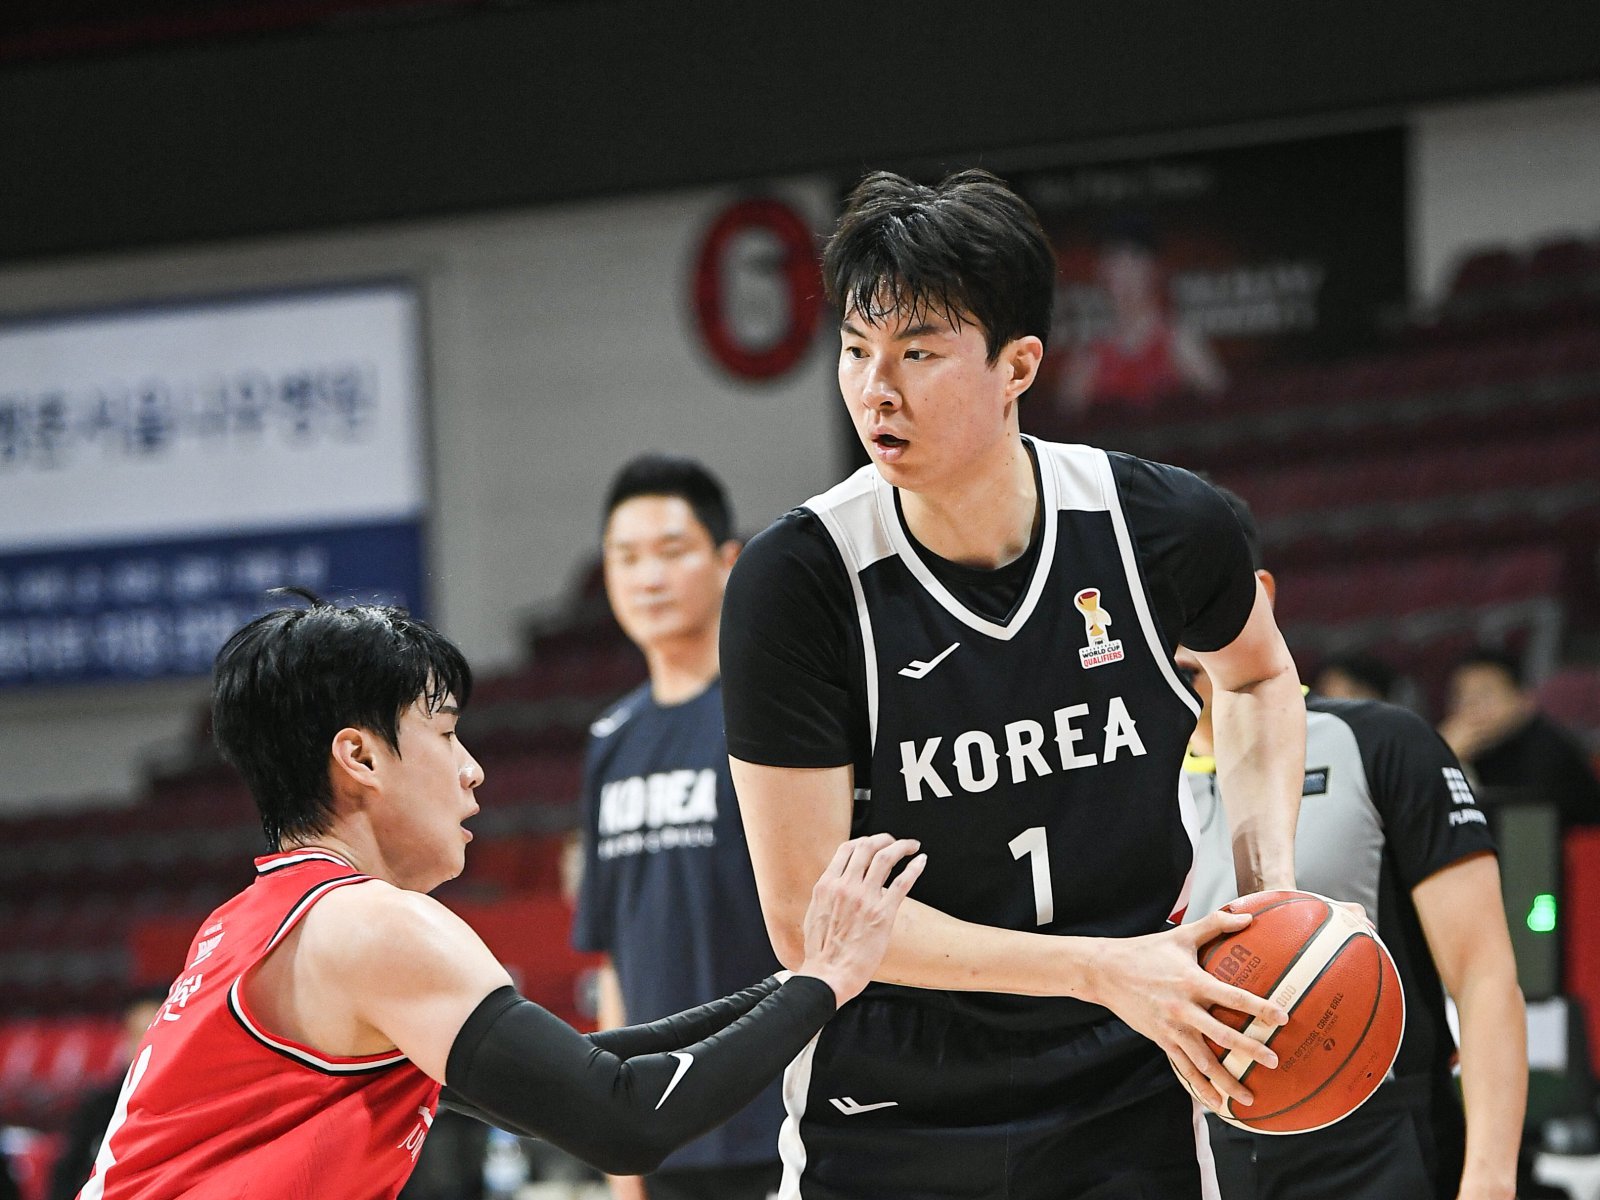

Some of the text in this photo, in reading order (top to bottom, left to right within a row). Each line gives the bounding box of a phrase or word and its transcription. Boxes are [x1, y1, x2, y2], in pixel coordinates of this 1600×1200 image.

[1082, 649, 1106, 659] WORLD
[1107, 645, 1120, 653] CUP
[1084, 651, 1122, 667] QUALIFIERS
[899, 696, 1148, 802] KOREA
[1007, 826, 1054, 926] 1
[1213, 944, 1252, 982] IBA
[1232, 955, 1261, 987] PROVED
[1317, 1007, 1334, 1030] GAME
[1330, 992, 1344, 1010] BALL
